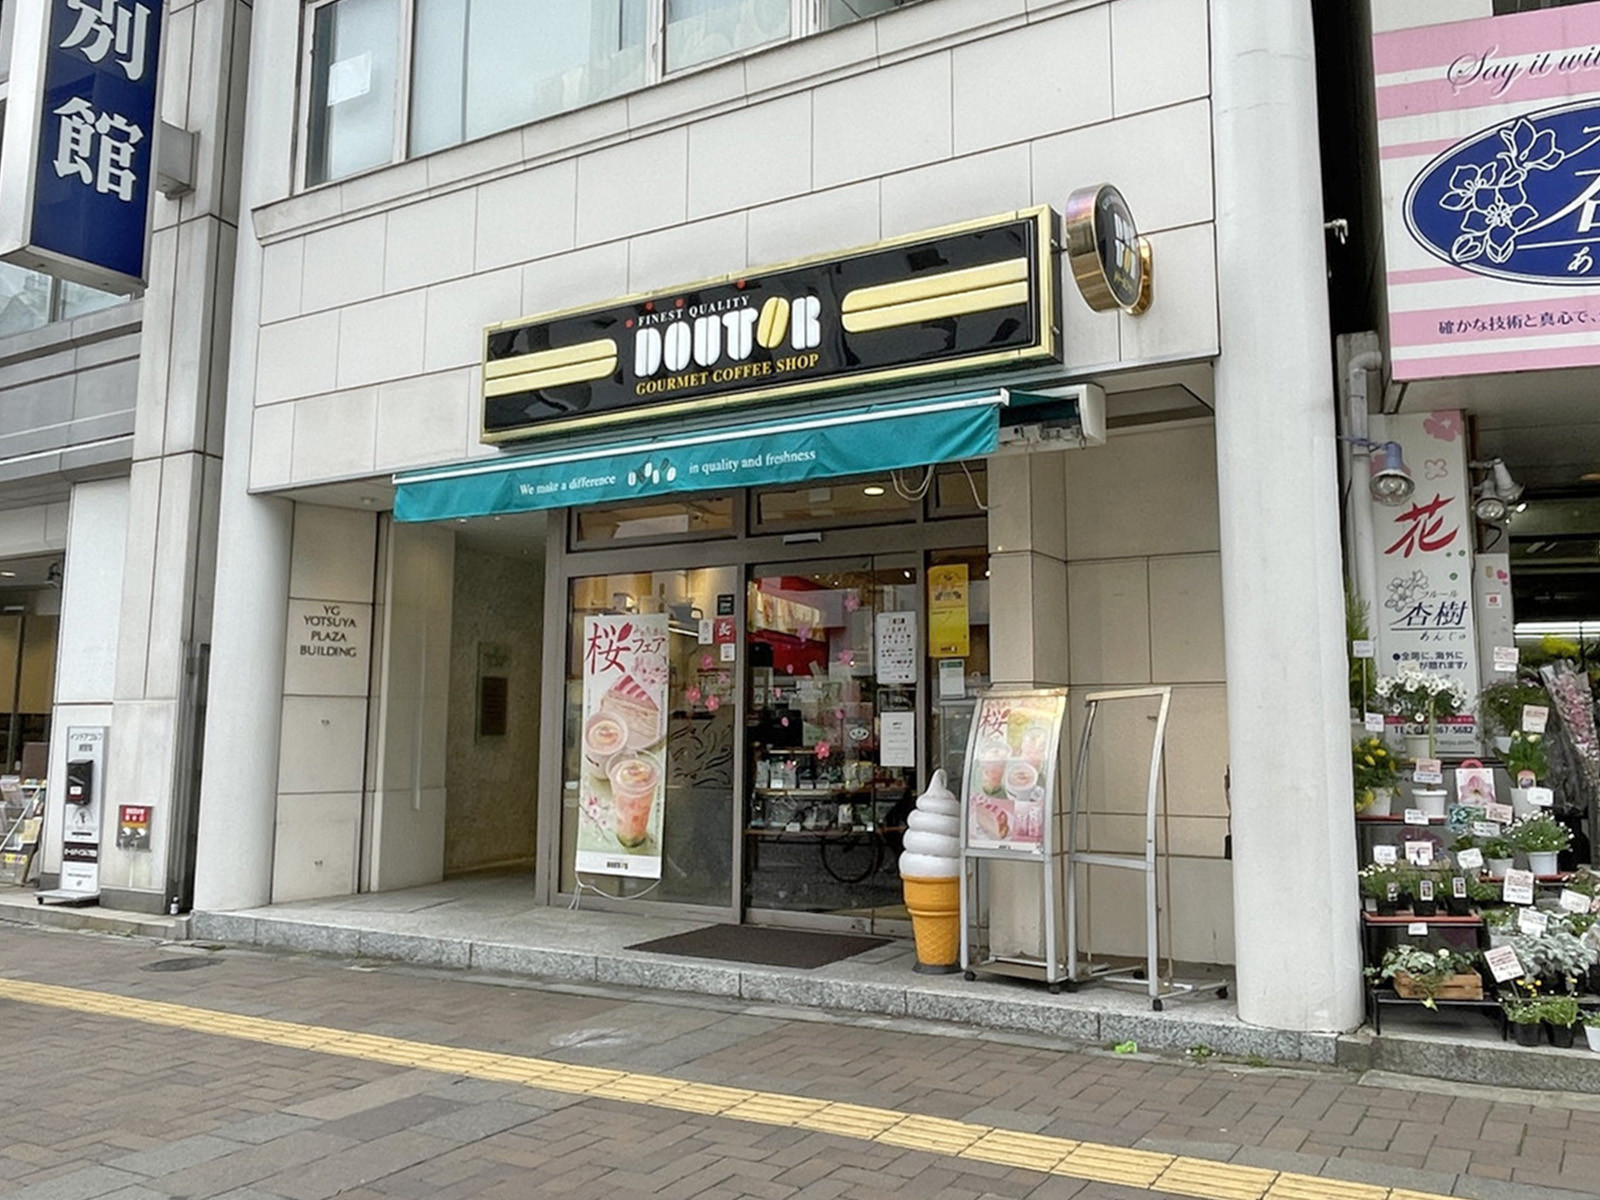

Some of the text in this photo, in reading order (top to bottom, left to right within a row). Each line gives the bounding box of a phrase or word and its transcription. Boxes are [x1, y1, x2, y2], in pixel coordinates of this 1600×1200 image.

[1447, 45, 1523, 97] Say
[1529, 53, 1556, 76] it
[52, 0, 152, 203] 別館
[1567, 246, 1594, 274] あ
[637, 295, 750, 327] FINEST QUALITY
[634, 296, 821, 377] DOUTOR
[636, 353, 819, 396] GOURMET COFFEE SHOP
[519, 484, 534, 495] We
[536, 482, 559, 494] make
[568, 475, 617, 490] difference
[689, 462, 699, 474] in
[701, 458, 739, 475] quality
[741, 455, 762, 468] and
[765, 450, 816, 466] freshness
[1384, 493, 1460, 558] 花
[304, 615, 357, 628] YOTSUYA
[1389, 601, 1468, 626] 杏樹
[300, 644, 357, 658] BUILDING
[310, 630, 347, 642] PLAZA
[584, 622, 666, 675] 桜 フェア
